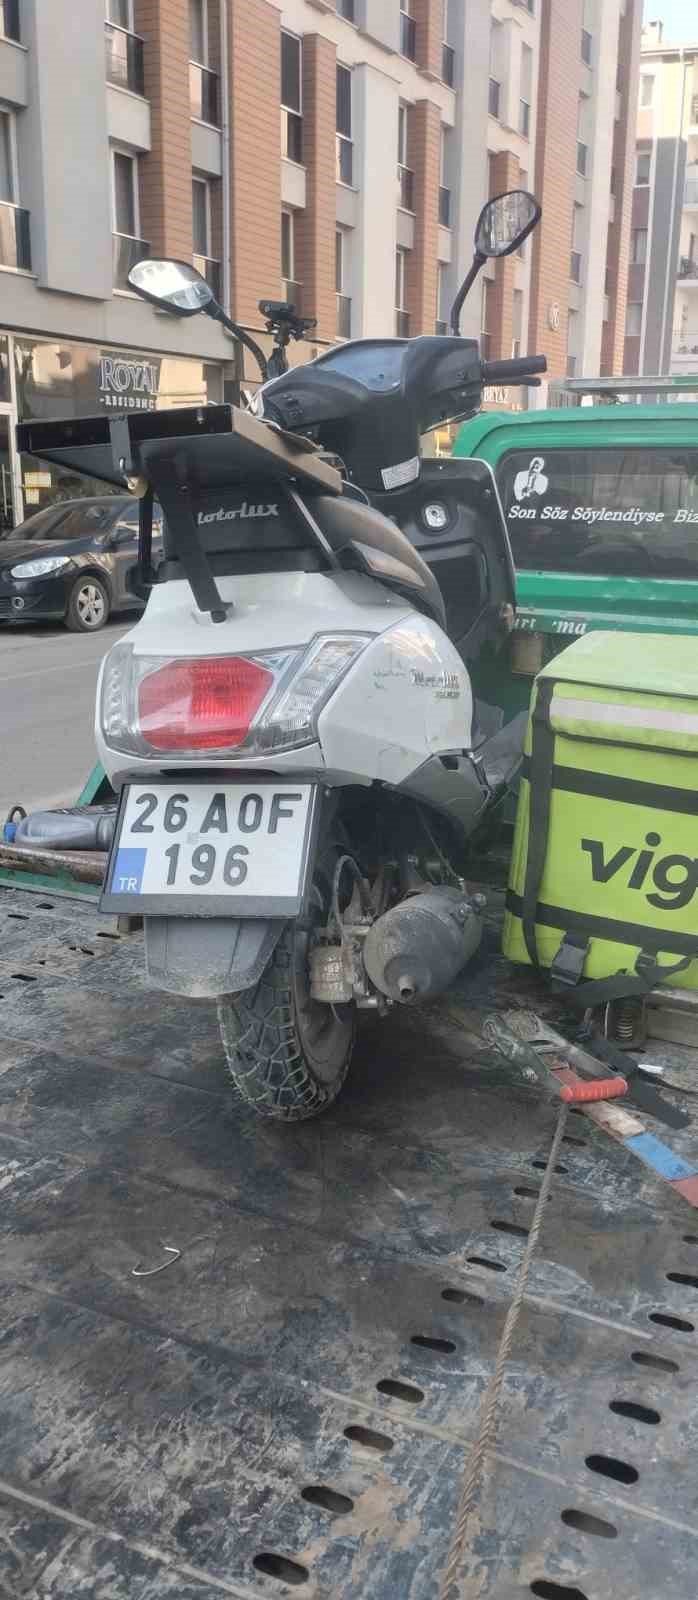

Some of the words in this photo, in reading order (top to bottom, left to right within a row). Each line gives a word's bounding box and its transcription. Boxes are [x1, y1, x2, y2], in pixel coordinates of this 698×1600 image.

[99, 358, 160, 394] ROYAL
[508, 505, 536, 519] Son
[540, 506, 569, 520] Söz
[571, 507, 664, 525] Söylendiyse
[130, 793, 190, 833] 26
[165, 843, 250, 887] 196
[119, 877, 138, 891] TR
